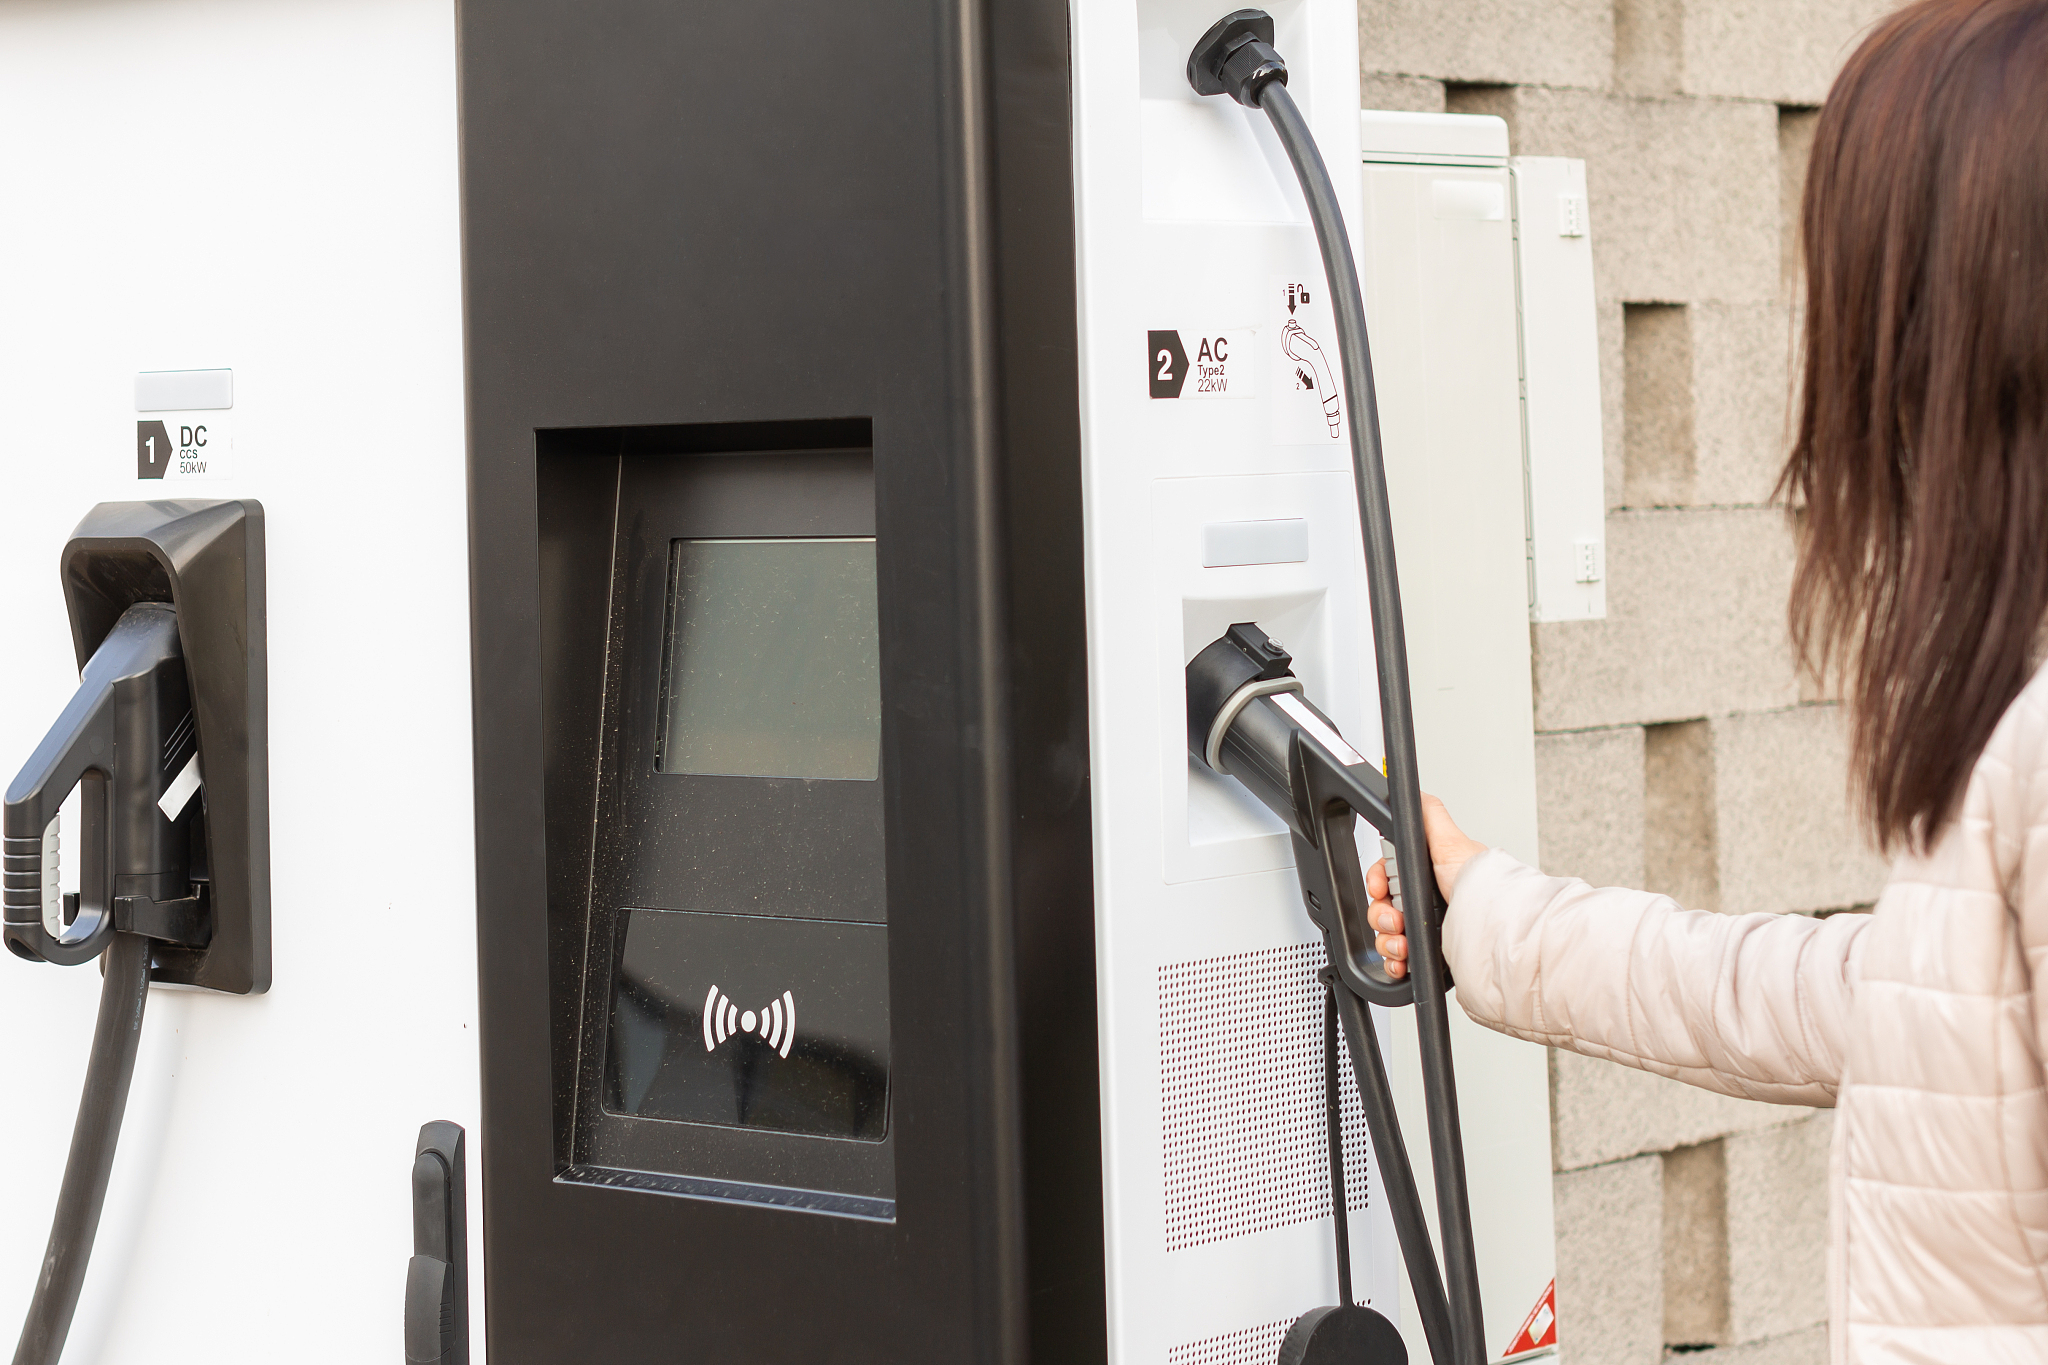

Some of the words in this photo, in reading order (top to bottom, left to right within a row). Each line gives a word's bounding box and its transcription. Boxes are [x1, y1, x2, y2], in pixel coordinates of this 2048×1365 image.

[1197, 337, 1228, 362] AC
[1157, 349, 1173, 381] 2
[1197, 364, 1225, 379] Type2
[1197, 379, 1228, 392] 22kW
[180, 425, 207, 447] DC
[145, 436, 155, 464] 1
[180, 449, 198, 459] CCS
[180, 462, 207, 473] 50kW
